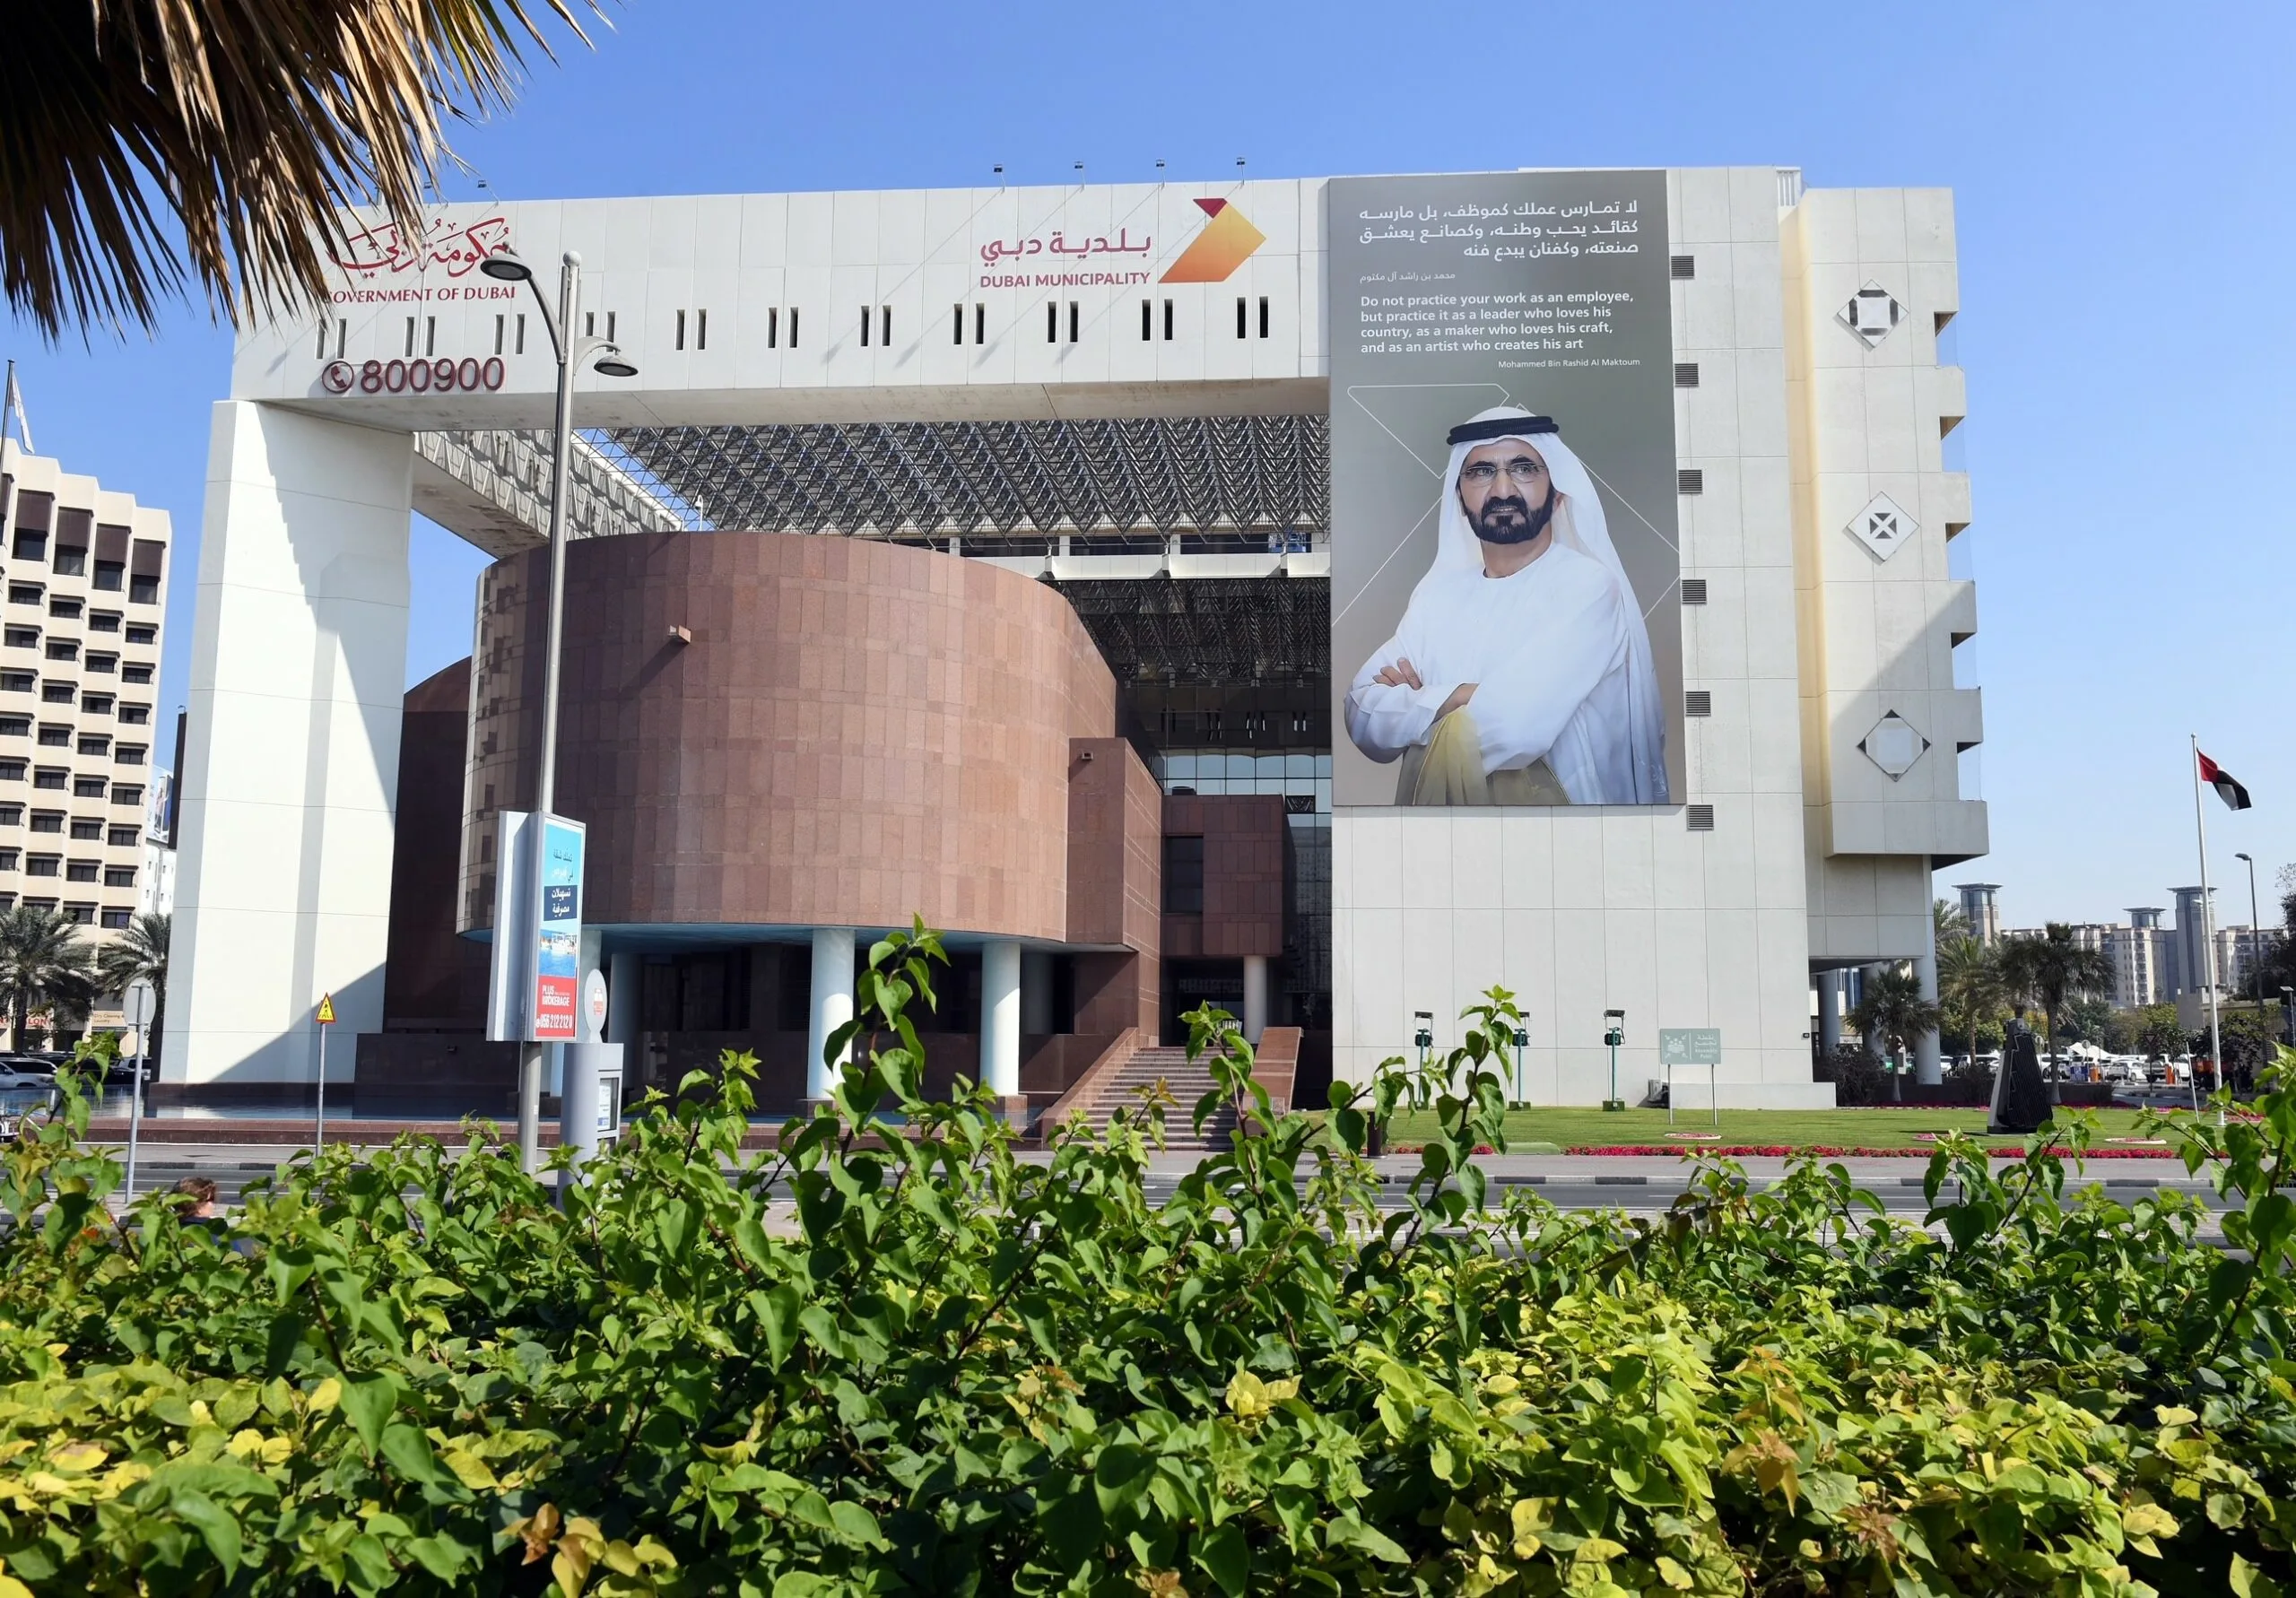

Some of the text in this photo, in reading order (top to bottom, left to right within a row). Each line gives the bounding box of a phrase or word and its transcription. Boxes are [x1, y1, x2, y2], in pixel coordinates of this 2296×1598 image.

[1419, 205, 1437, 221] بل
[1443, 203, 1509, 219] كموظف،
[1513, 202, 1556, 215] عملك
[1625, 200, 1638, 213] لا
[980, 227, 1151, 267] بلدية دبي
[1464, 241, 1639, 263] صنعته، وكفنان يبدع فنه
[979, 272, 1150, 288] DUBAI MUNICIPALITY
[1360, 273, 1385, 284] مكتوم
[1387, 271, 1397, 282] آل
[1399, 272, 1418, 282] راشد
[1421, 273, 1431, 282] بن
[331, 286, 516, 303] OVERNMENT OF DUBAI
[1361, 291, 1633, 308] Do not practice your work as an employee,
[1361, 306, 1612, 324] but practice it as a leader who loves his
[1361, 322, 1613, 339] country, as a maker who loves his craft,
[1361, 338, 1584, 352] and as an artist who creates his art
[1499, 360, 1545, 368] Mohammed
[1563, 359, 1588, 367] Rashid
[360, 357, 506, 394] 800900
[542, 985, 554, 995] PLUS
[542, 995, 570, 1006] BROKERAGE
